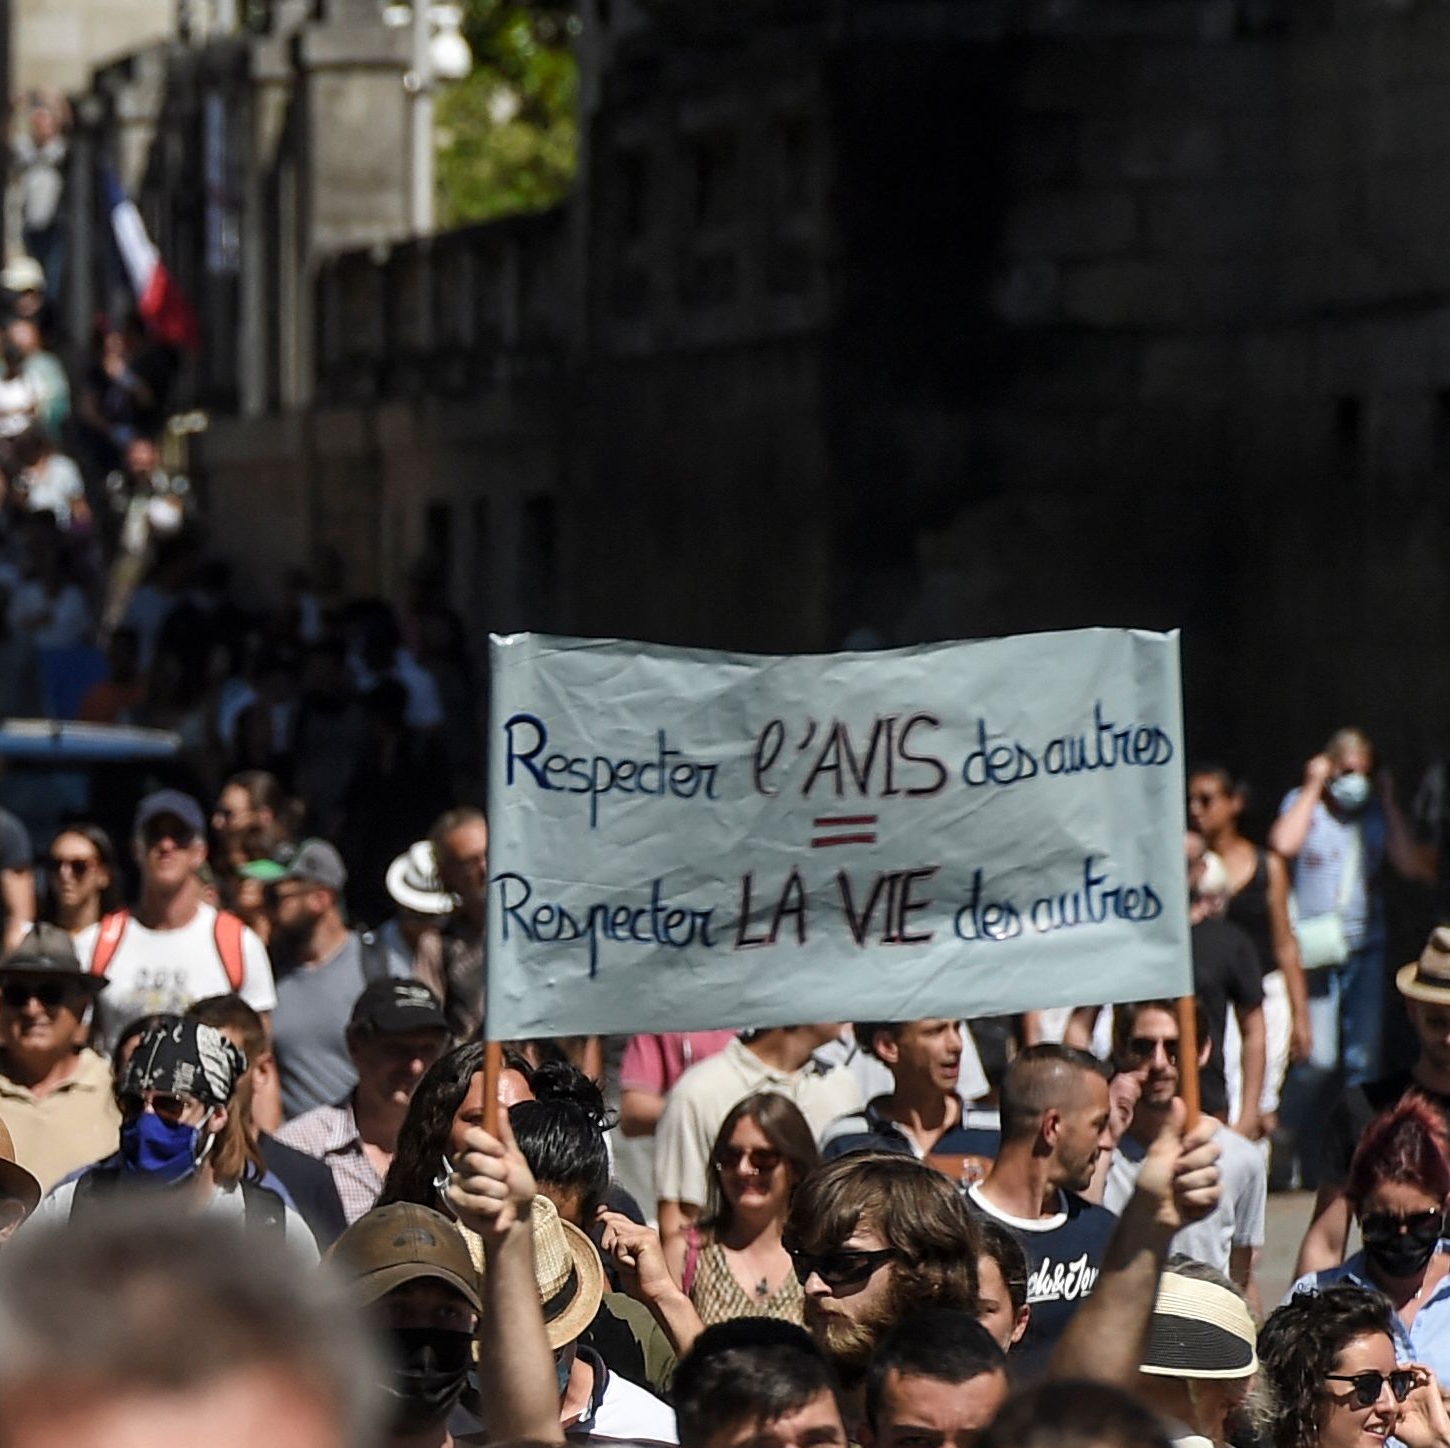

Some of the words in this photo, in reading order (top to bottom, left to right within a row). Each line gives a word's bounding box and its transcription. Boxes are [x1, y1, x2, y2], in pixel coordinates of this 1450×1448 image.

[504, 714, 719, 827] Respecter
[753, 709, 949, 798] l'AVIS
[963, 718, 1037, 786] des
[1043, 699, 1173, 776] autres
[490, 872, 719, 979] Respecter
[734, 865, 807, 951] LA
[835, 865, 941, 947] VIE
[954, 868, 1023, 941] des
[1028, 855, 1163, 933] autres
